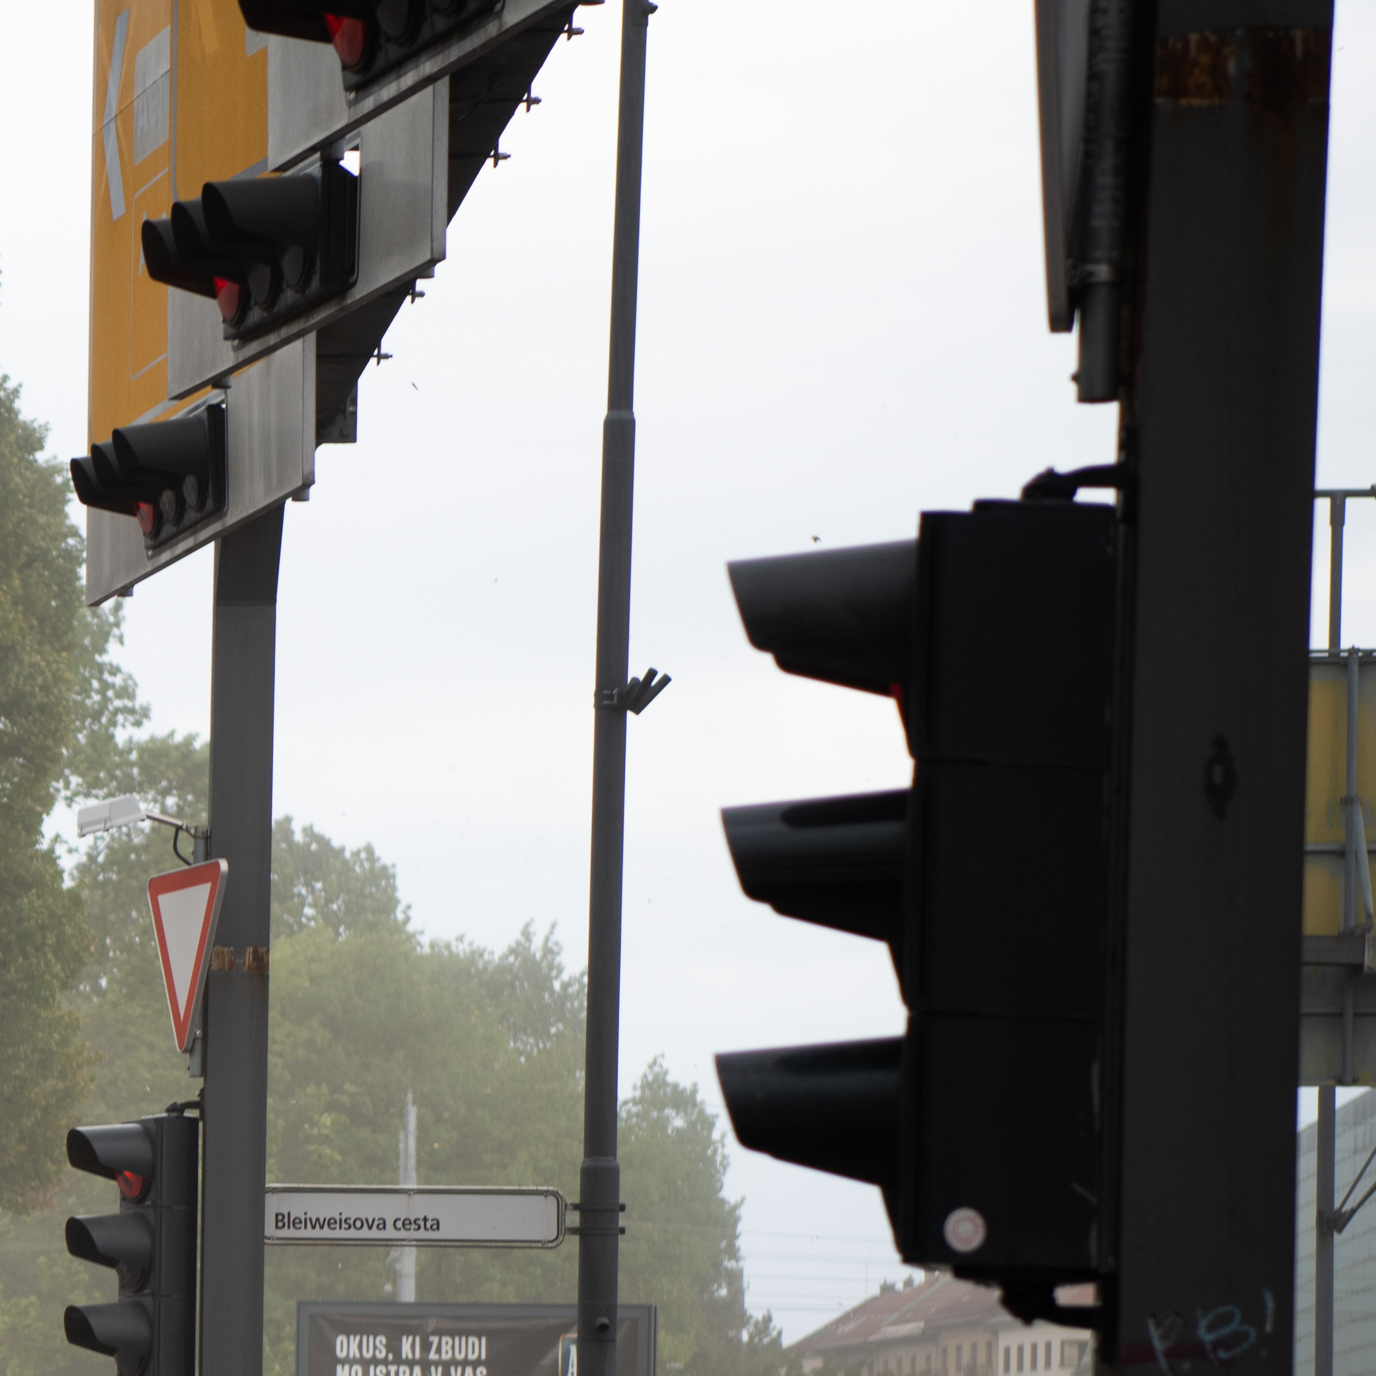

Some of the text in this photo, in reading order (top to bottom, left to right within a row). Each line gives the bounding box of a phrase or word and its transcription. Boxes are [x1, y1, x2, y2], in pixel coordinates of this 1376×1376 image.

[274, 1211, 440, 1232] Bleiweisova cesta
[335, 1334, 487, 1362] OKUS, KI ZBUDI
